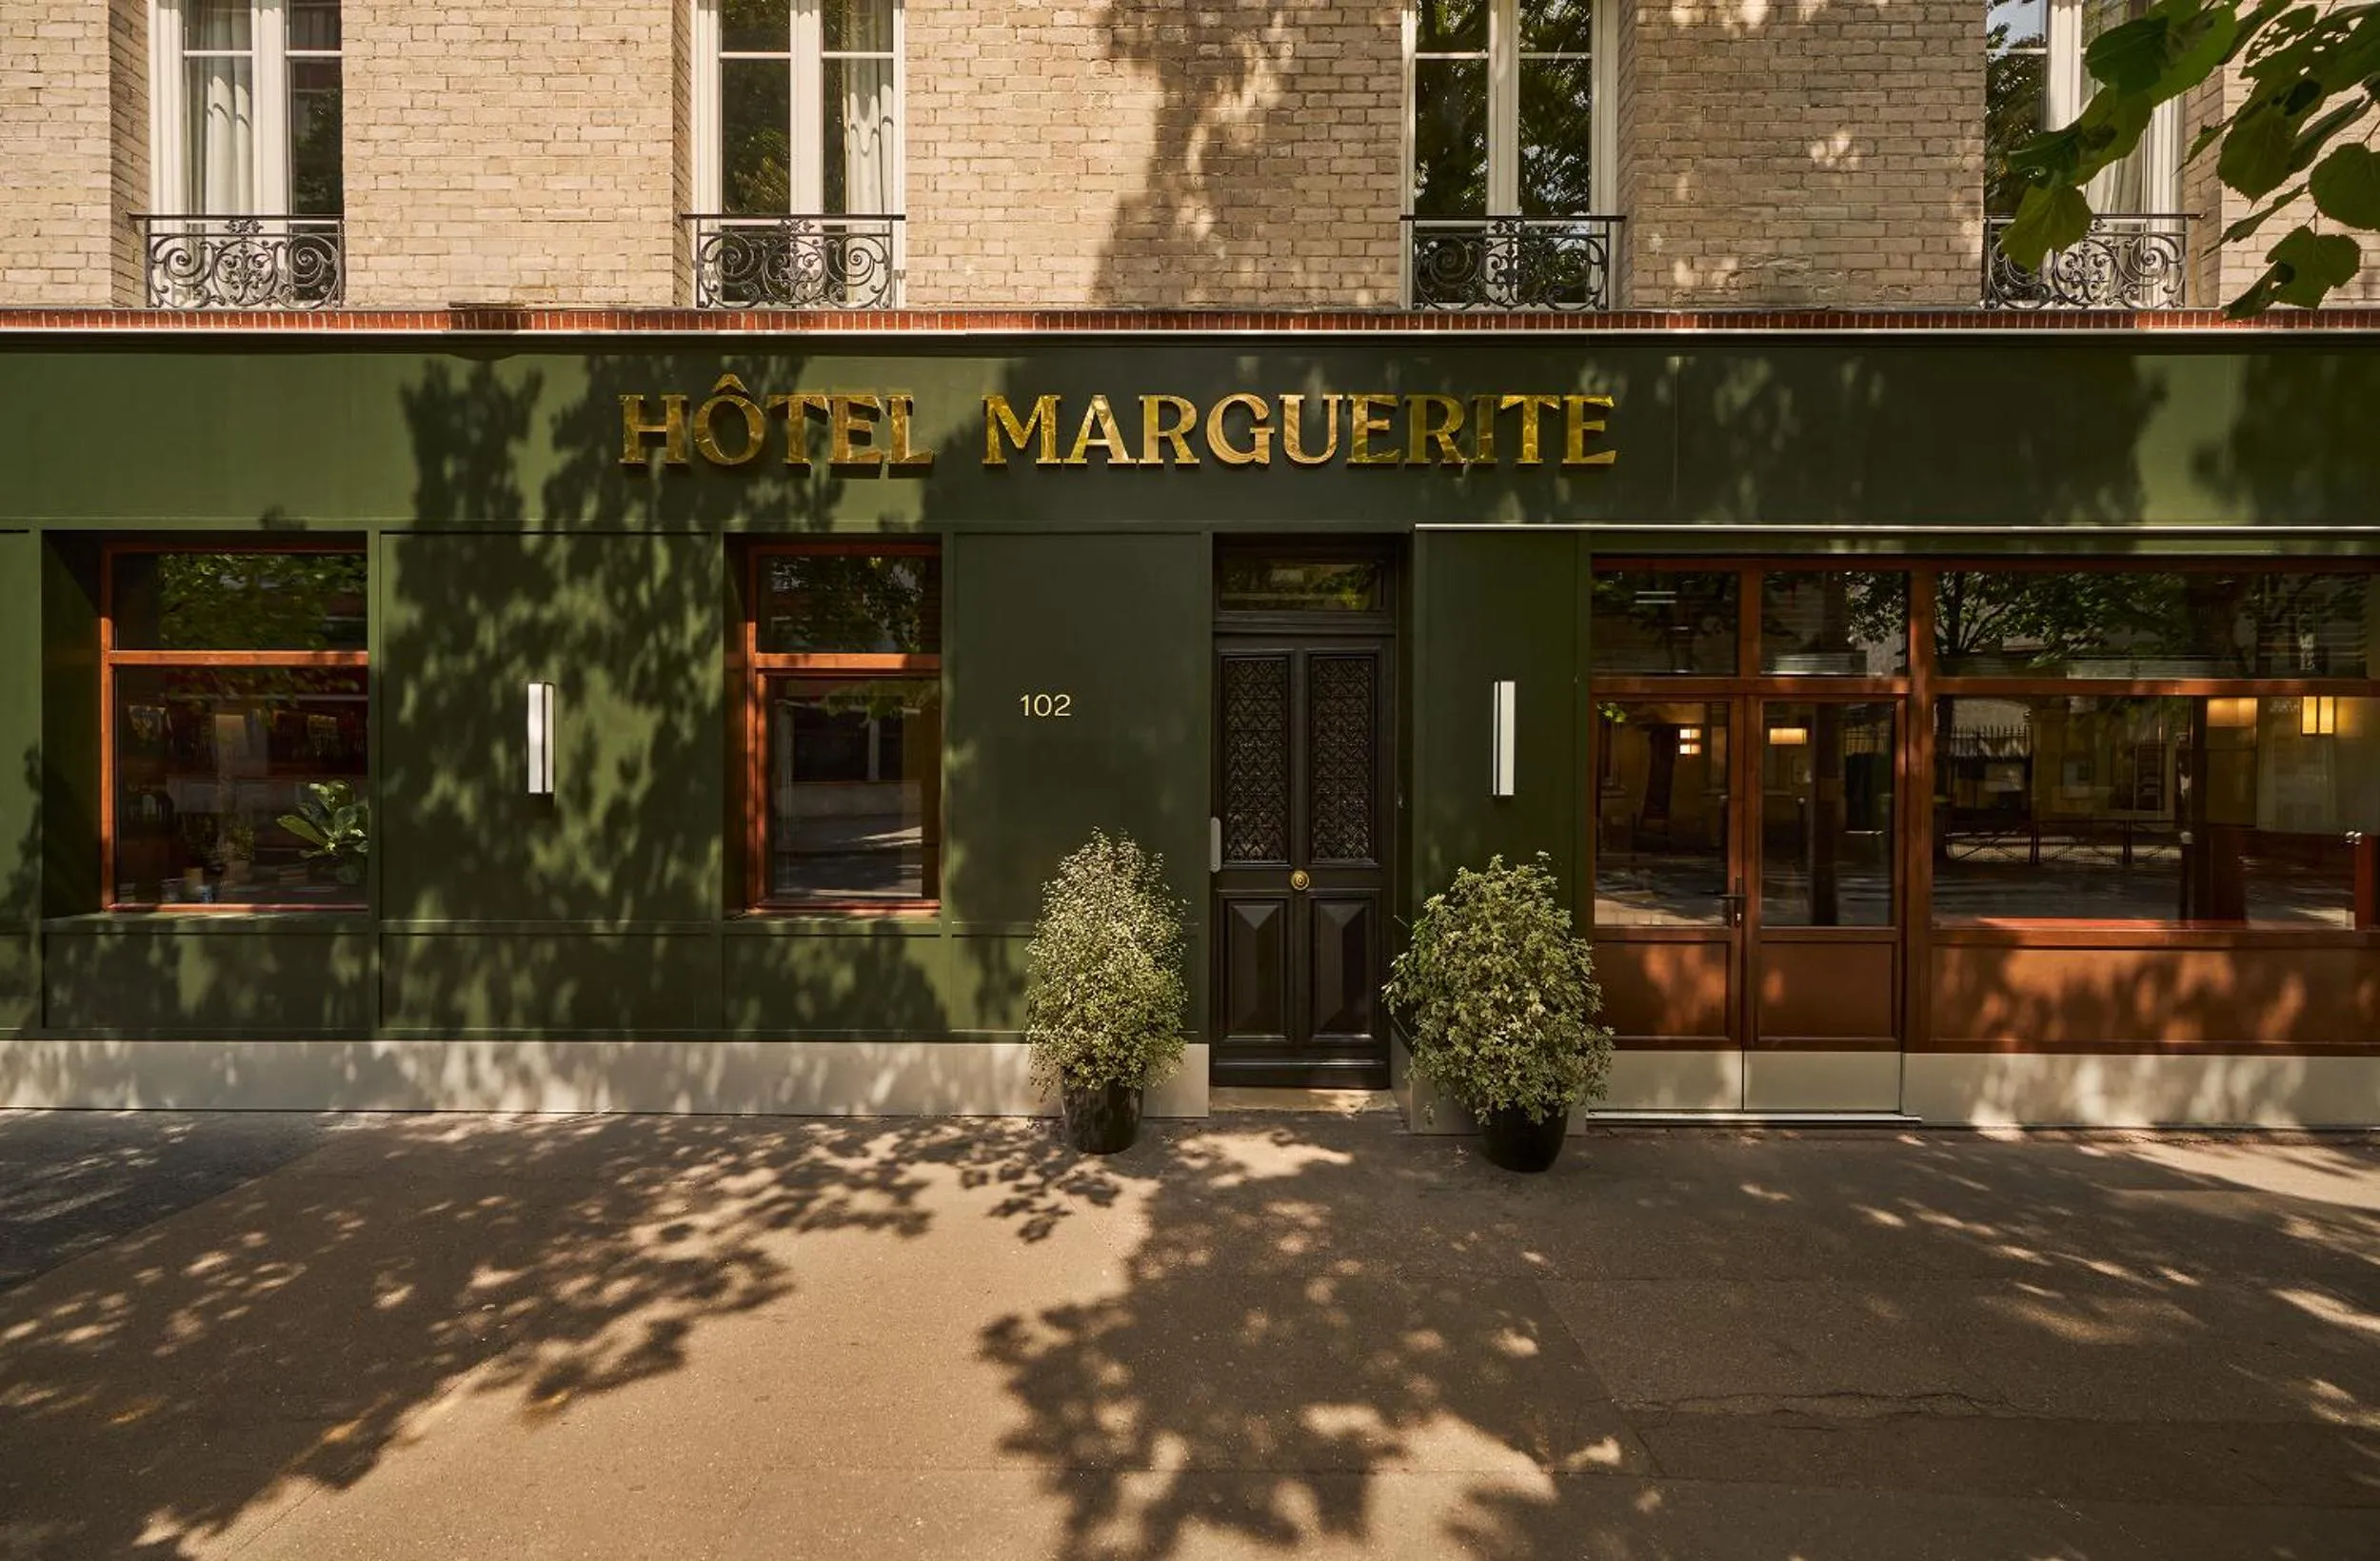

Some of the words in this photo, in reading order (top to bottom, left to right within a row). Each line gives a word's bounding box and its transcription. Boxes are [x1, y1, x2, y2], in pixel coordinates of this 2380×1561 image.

[618, 373, 935, 468] HÔTEL
[982, 393, 1616, 466] MARGUERITE
[1020, 694, 1072, 717] 102
